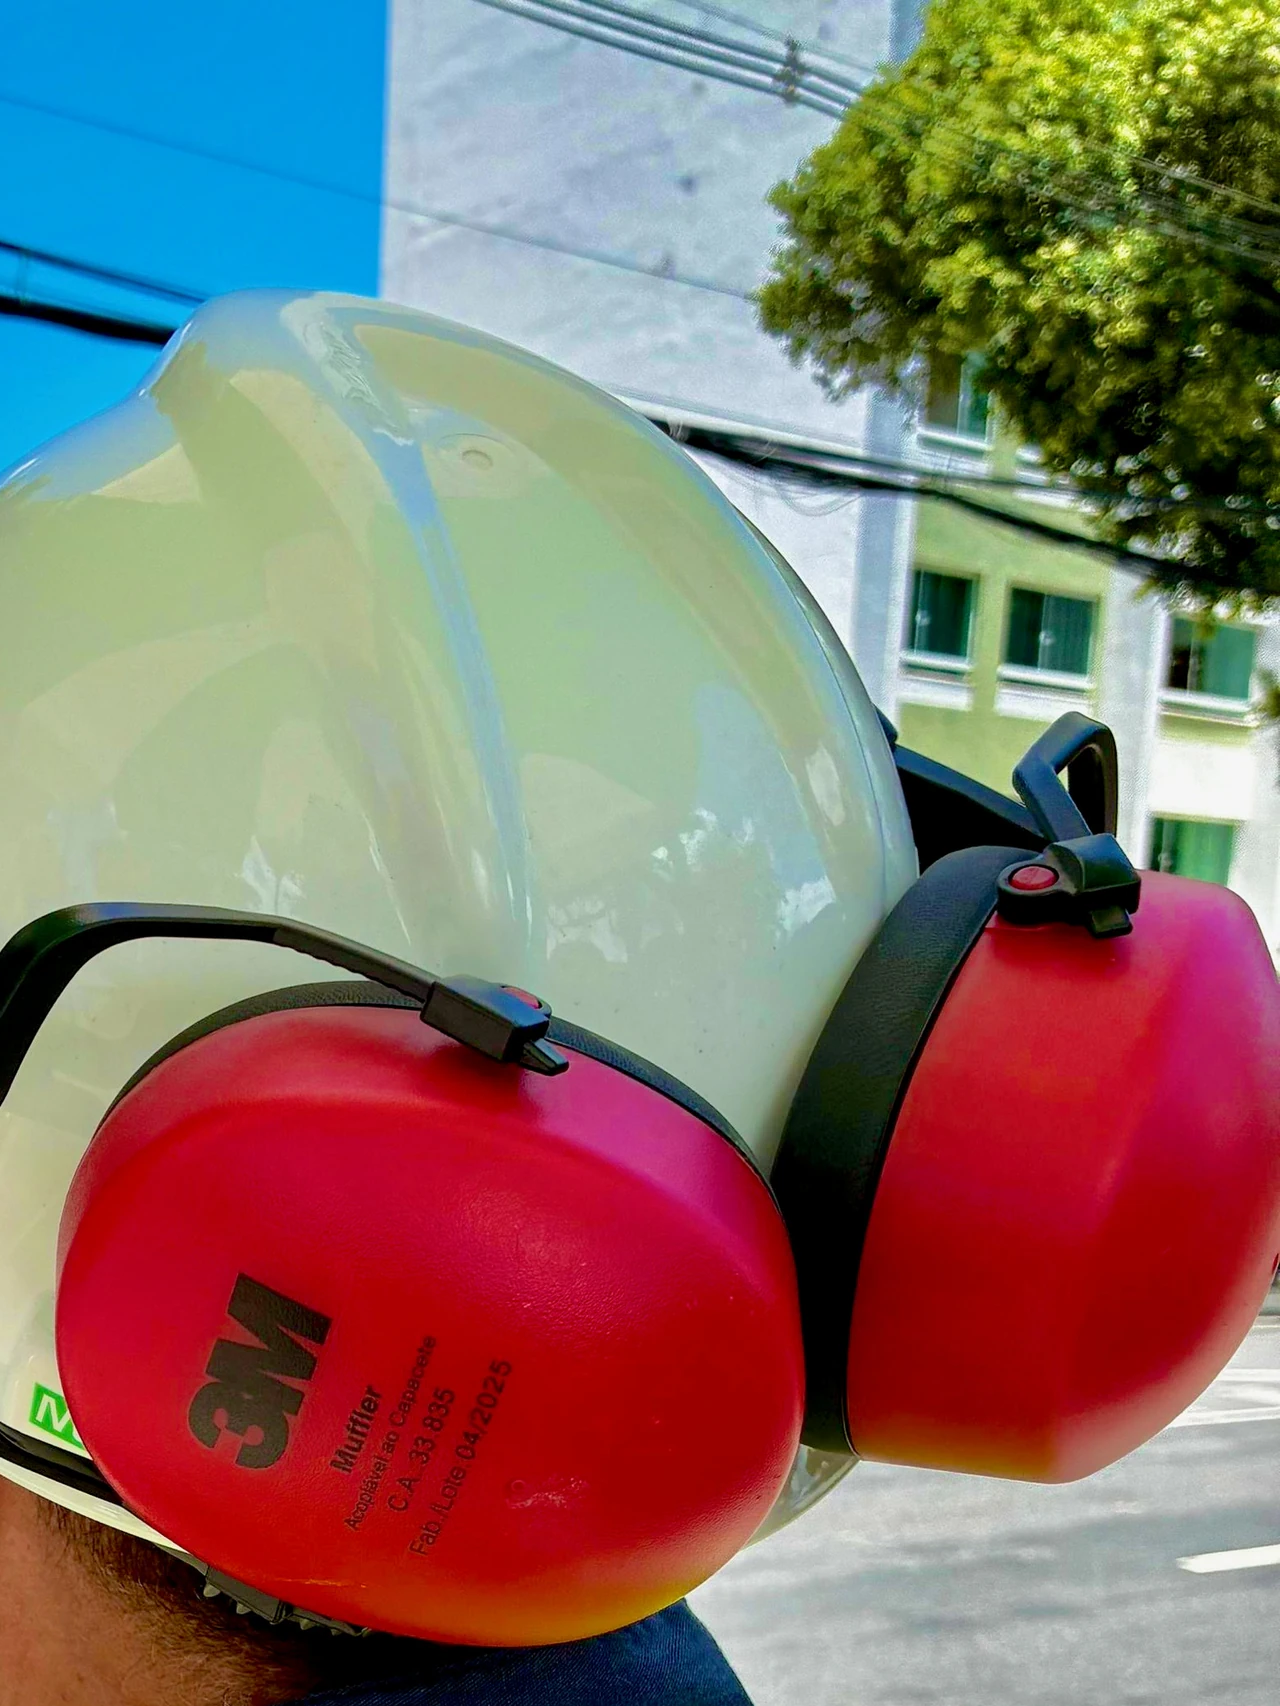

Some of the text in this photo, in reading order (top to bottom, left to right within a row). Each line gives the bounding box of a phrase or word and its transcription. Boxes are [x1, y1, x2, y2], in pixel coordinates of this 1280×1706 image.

[188, 1272, 333, 1470] 3M
[387, 1335, 437, 1428] Capacete
[329, 1385, 383, 1475] Muffler
[381, 1429, 401, 1455] ao
